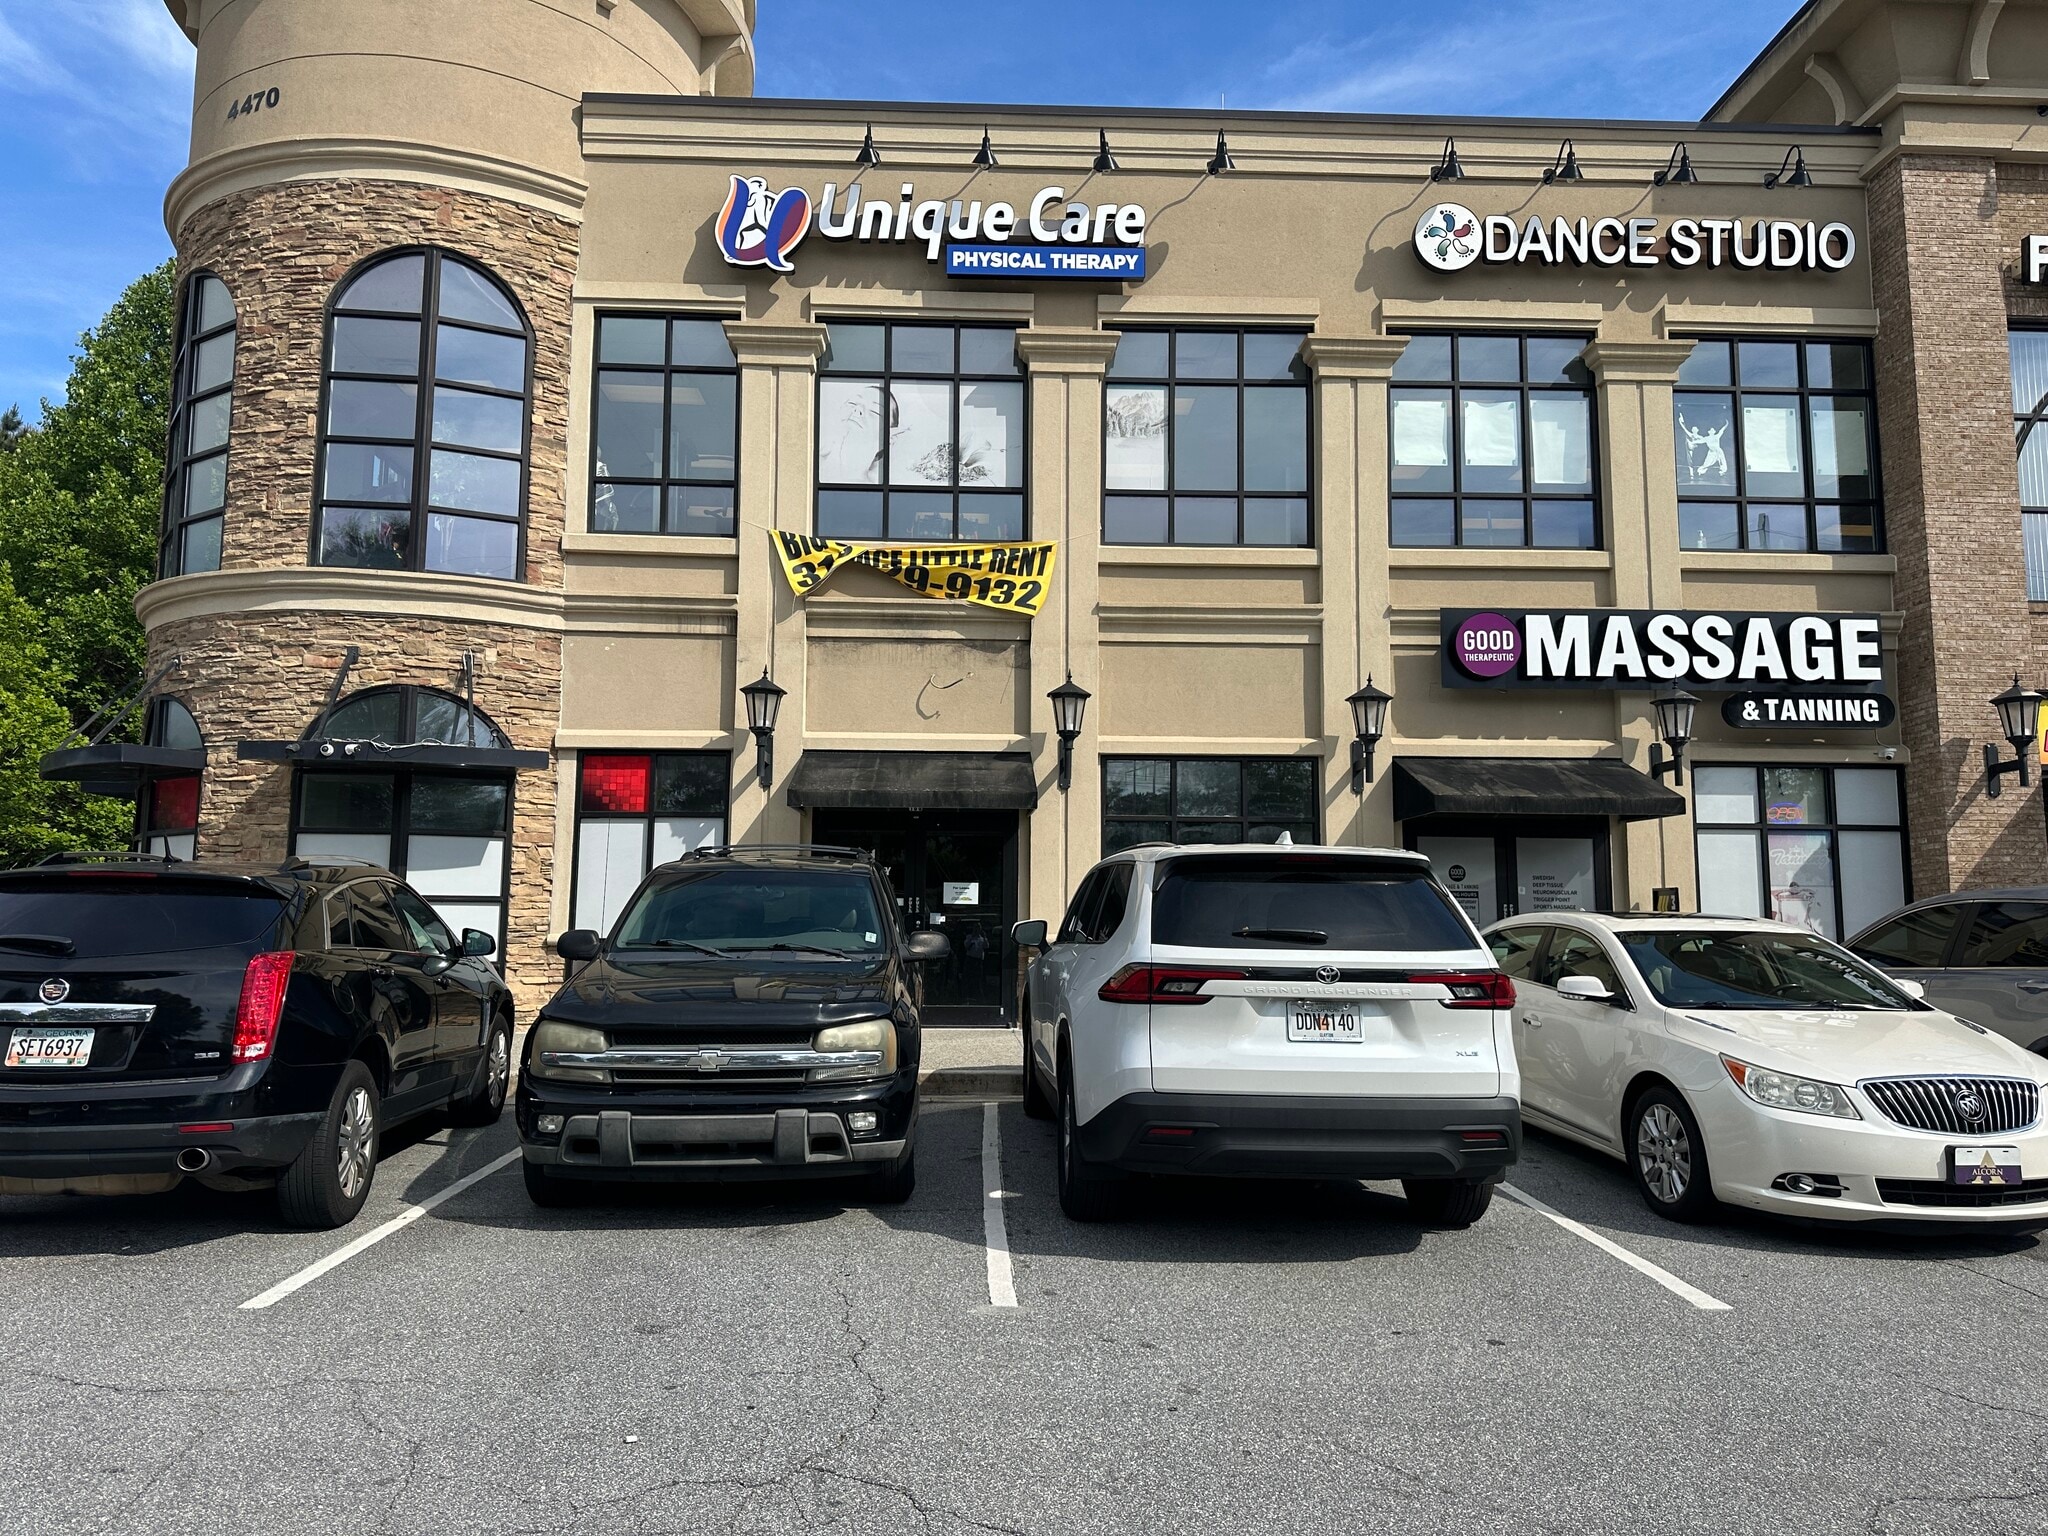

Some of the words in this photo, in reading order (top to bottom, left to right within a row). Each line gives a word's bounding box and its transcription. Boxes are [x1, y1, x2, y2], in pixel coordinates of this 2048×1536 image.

[227, 86, 280, 119] 4470
[819, 182, 1015, 260] Unique
[1029, 186, 1145, 245] Care
[1485, 215, 1659, 265] DANCE
[1670, 219, 1856, 269] STUDIO
[952, 251, 1046, 269] PHYSICAL
[1050, 252, 1138, 270] THERAPY
[989, 545, 1054, 577] RENT
[1463, 630, 1515, 651] GOOD
[1525, 614, 1882, 682] MASSAGE
[1464, 652, 1515, 662] THERAPEUTIC
[1742, 700, 1760, 722] &
[1763, 698, 1880, 723] TANNING
[1243, 986, 1302, 995] GRAND
[1306, 987, 1413, 996] HIGHLANDER
[1296, 1012, 1355, 1031] DDN4140
[16, 1038, 85, 1057] SET6937
[1972, 1168, 2003, 1176] ALCORN
